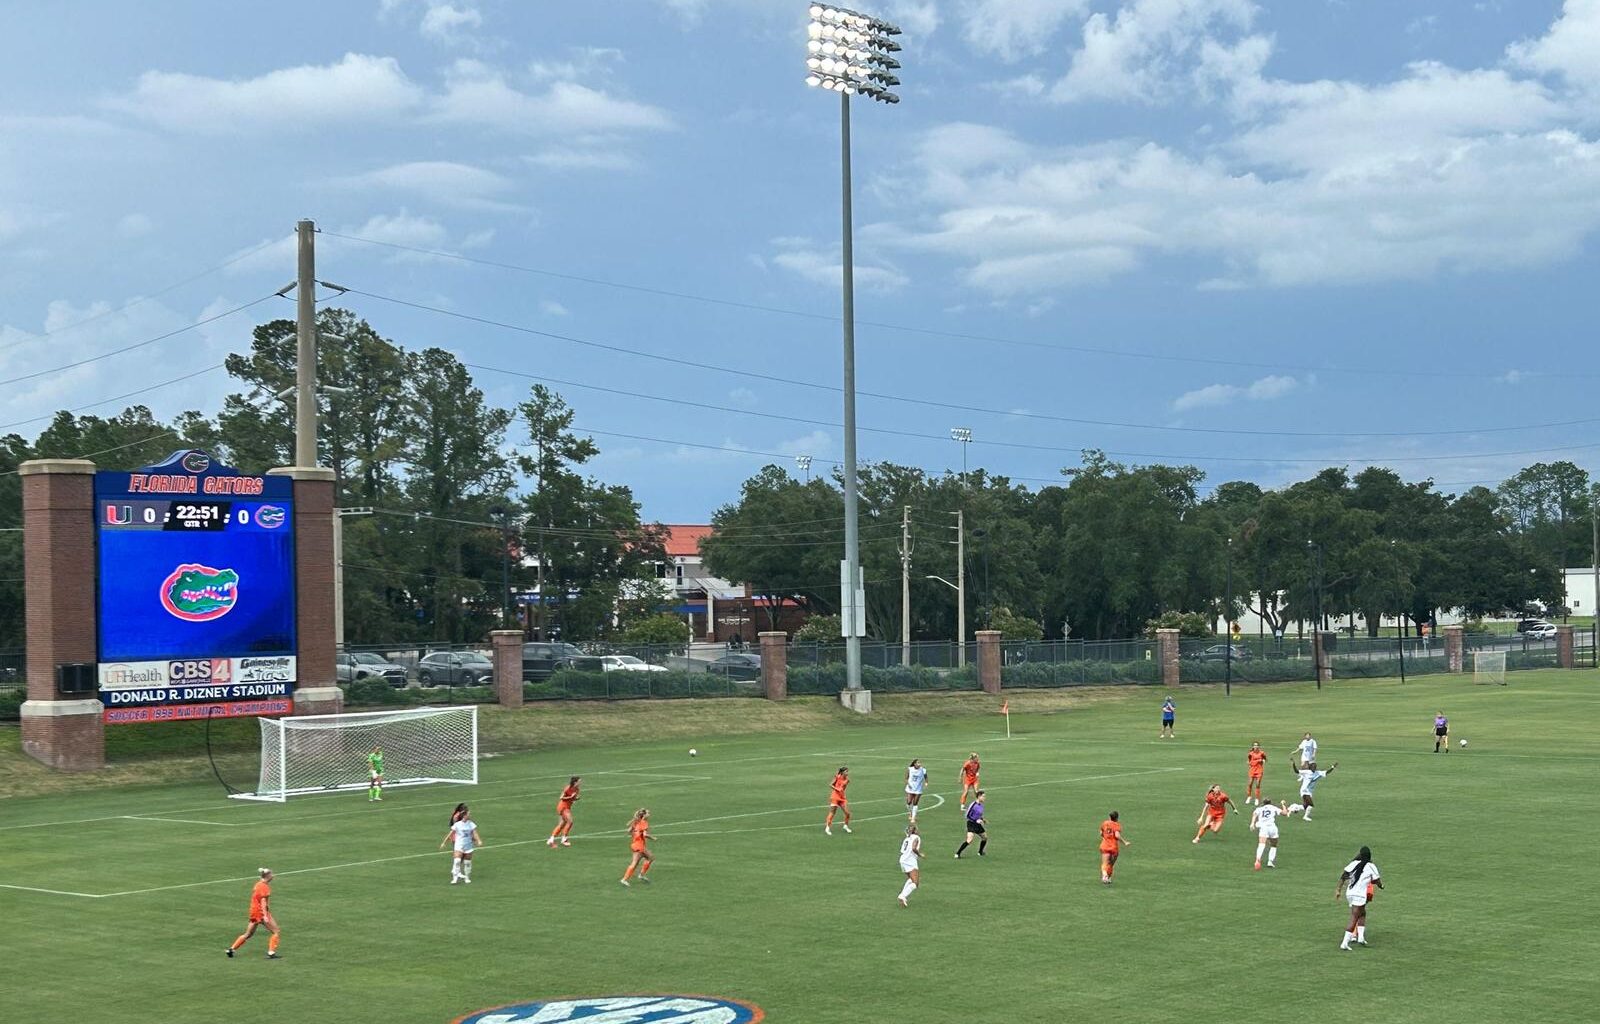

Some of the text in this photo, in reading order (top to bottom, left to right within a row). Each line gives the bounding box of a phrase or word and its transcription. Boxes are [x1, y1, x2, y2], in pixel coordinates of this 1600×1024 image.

[128, 474, 263, 494] FLORIDA GATORS
[106, 505, 132, 524] U
[143, 507, 156, 523] 0
[176, 505, 218, 519] 22:51
[238, 510, 249, 524] 0
[170, 660, 231, 682] CBS 4
[111, 684, 285, 703] DONALD R. DIZNEY STADIUM
[1262, 810, 1271, 818] 12
